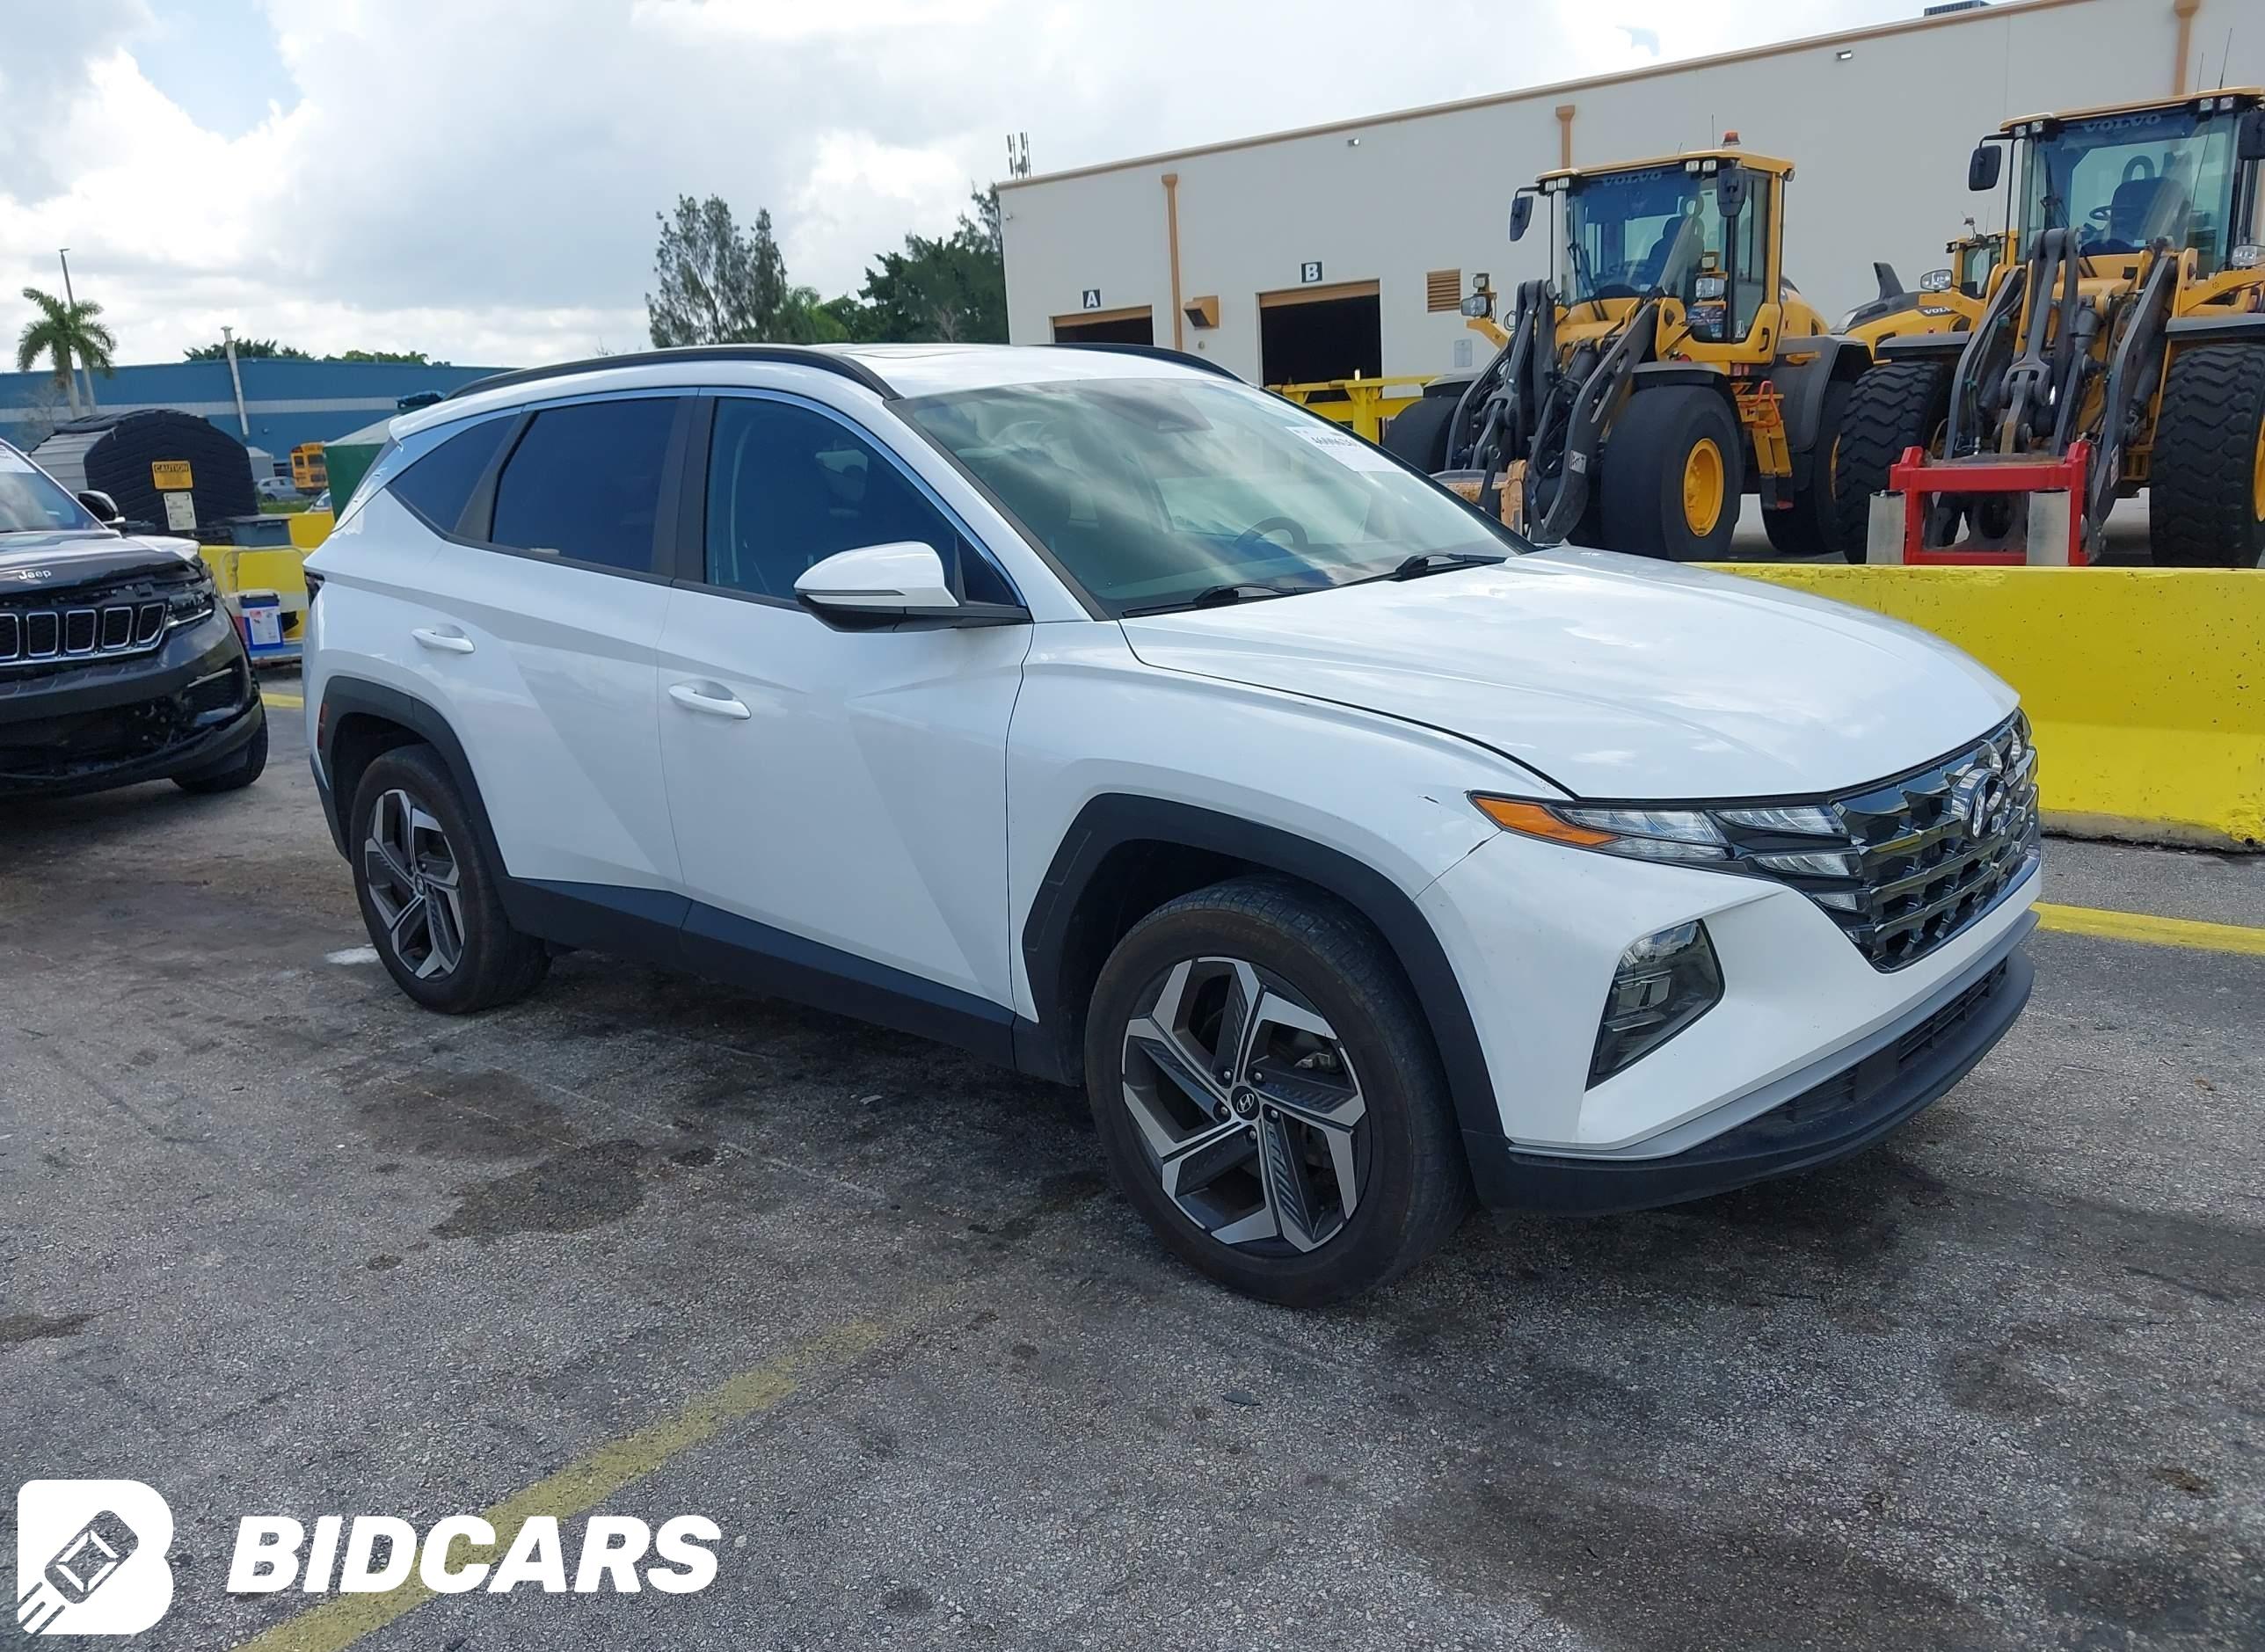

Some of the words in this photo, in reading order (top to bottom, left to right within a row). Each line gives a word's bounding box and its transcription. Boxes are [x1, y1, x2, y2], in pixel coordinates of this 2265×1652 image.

[2083, 113, 2161, 133] VOLVO
[1603, 169, 1662, 186] VOLVO
[1305, 263, 1319, 282] B
[1086, 291, 1098, 308] A
[155, 463, 190, 472] CAUTION
[18, 570, 52, 580] Jeep
